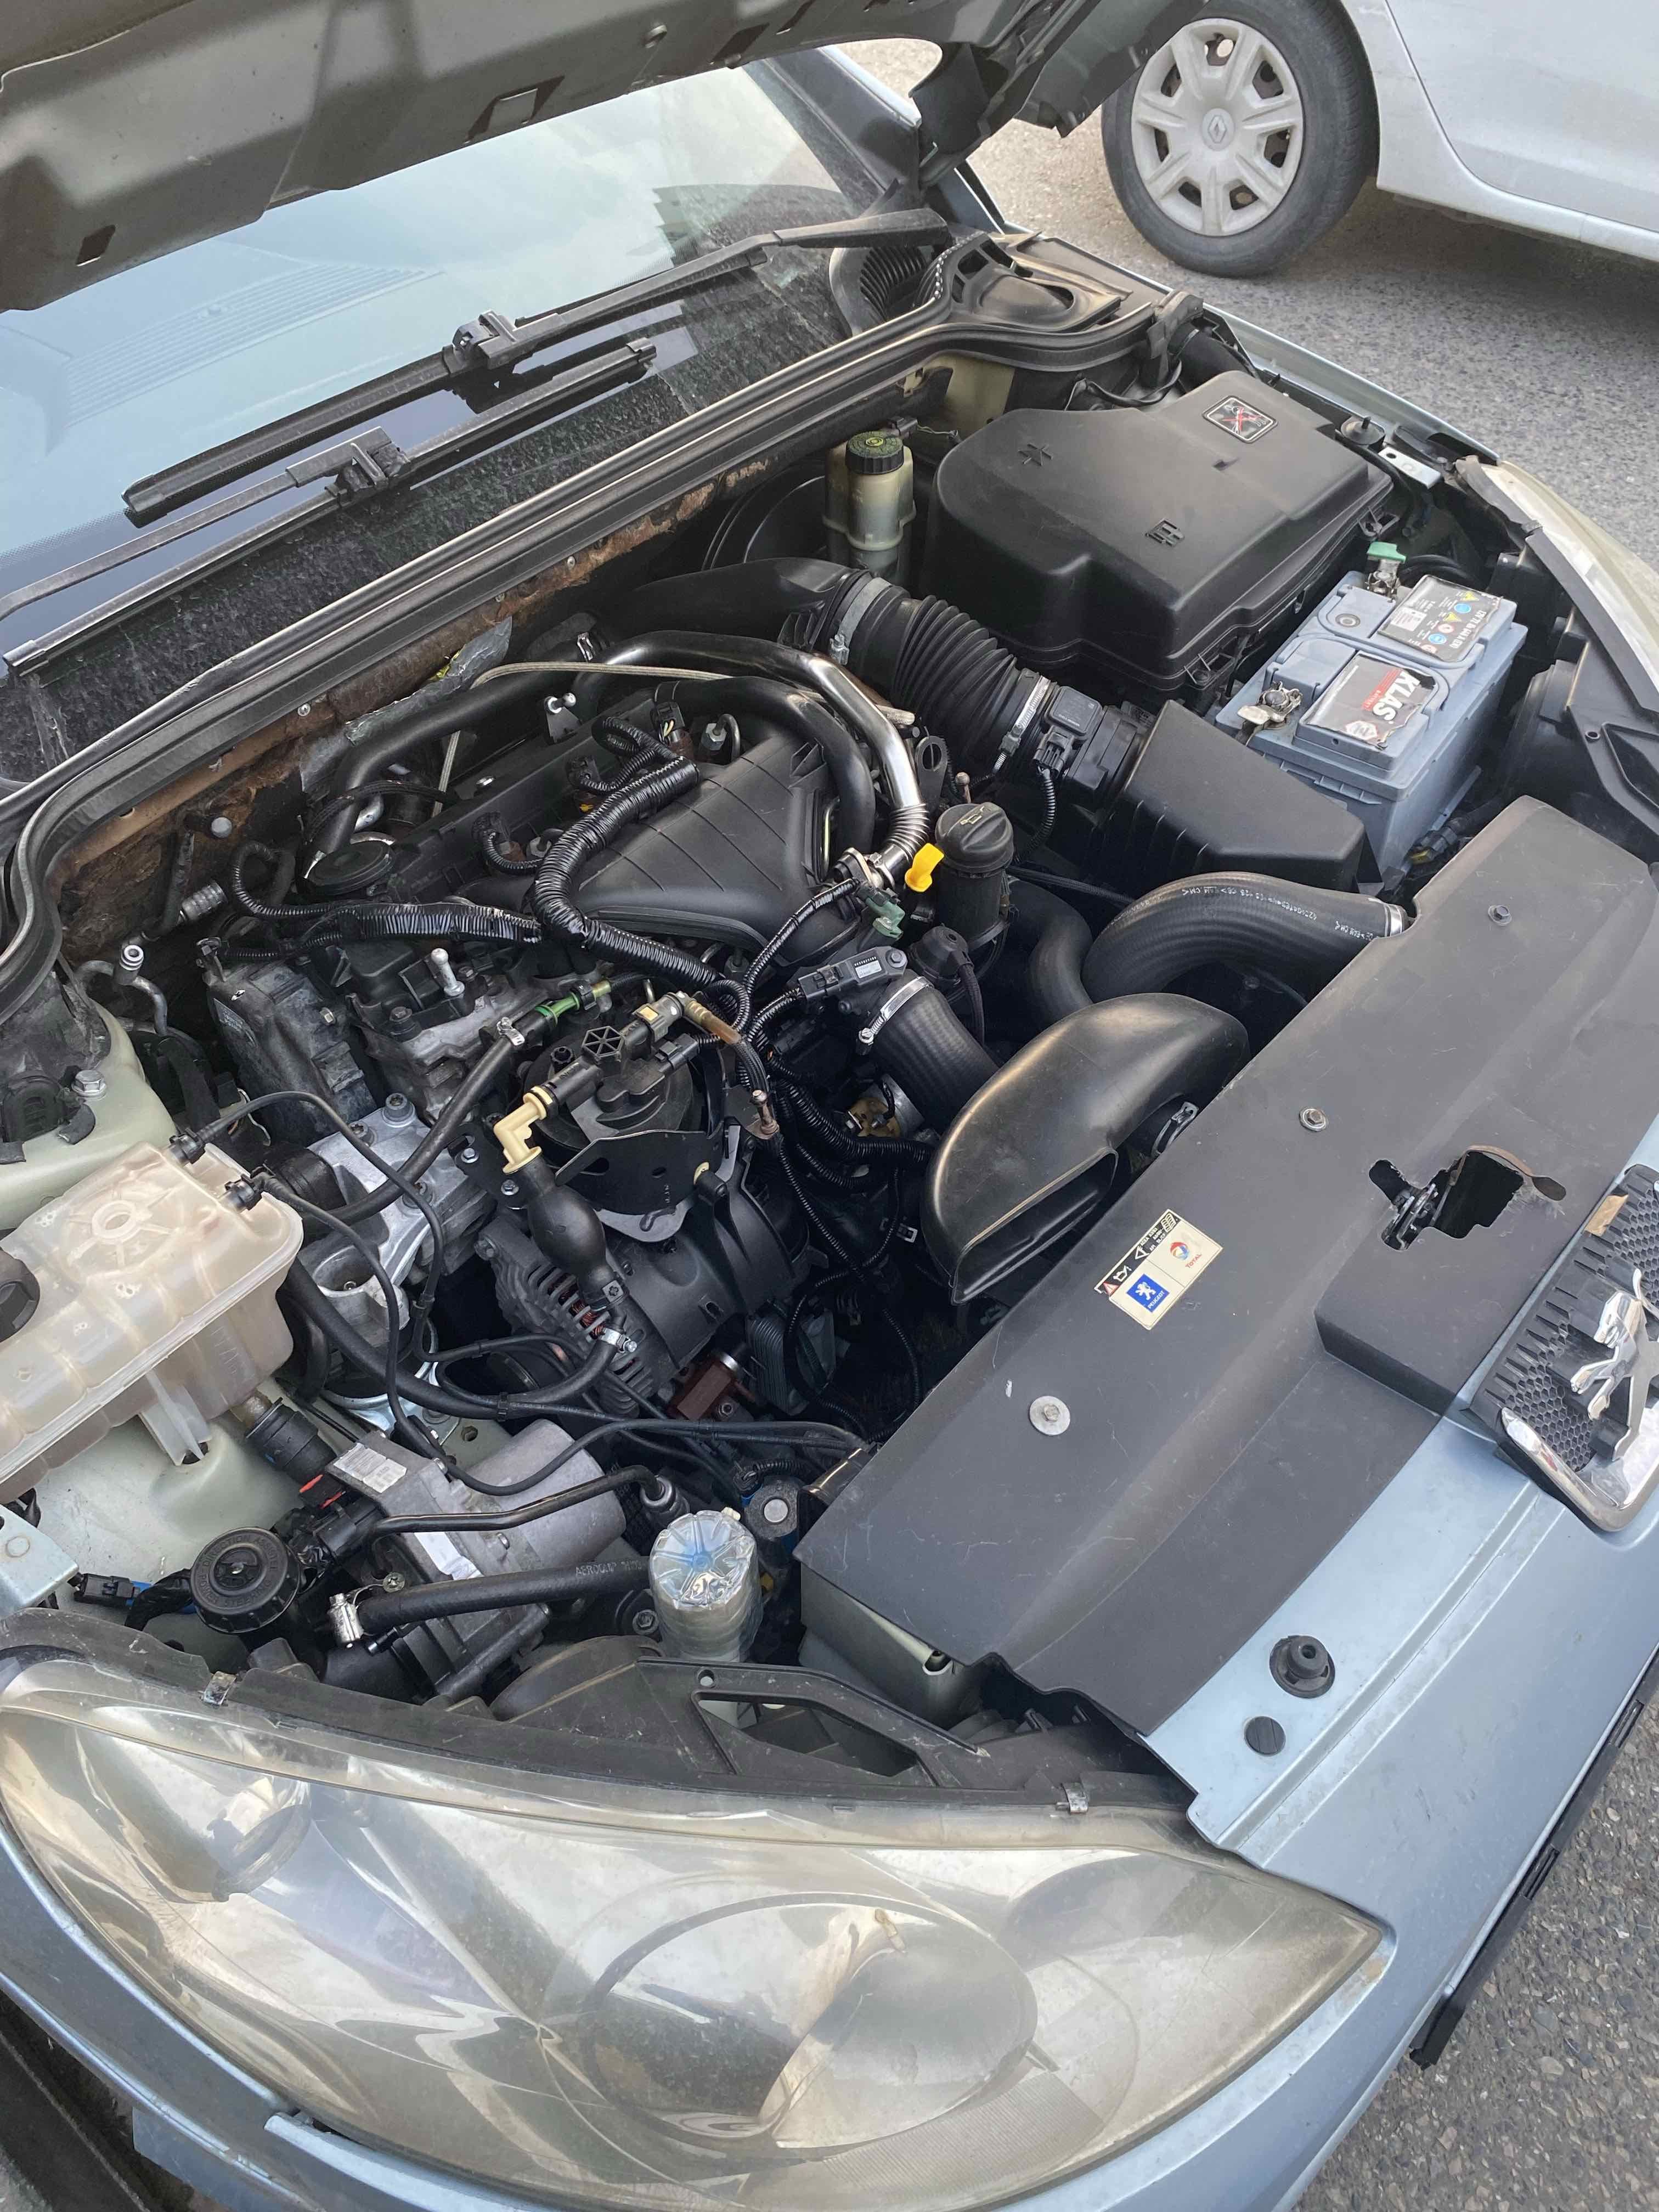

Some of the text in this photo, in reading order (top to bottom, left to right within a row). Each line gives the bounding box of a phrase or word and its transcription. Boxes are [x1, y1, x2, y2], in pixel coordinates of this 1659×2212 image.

[1373, 671, 1420, 721] KLAS
[1185, 1254, 1202, 1268] TOTAL
[1147, 1290, 1165, 1309] PEUGEOT
[202, 1535, 250, 1566] DIRECTION
[199, 1574, 273, 1607] POWER STEERING
